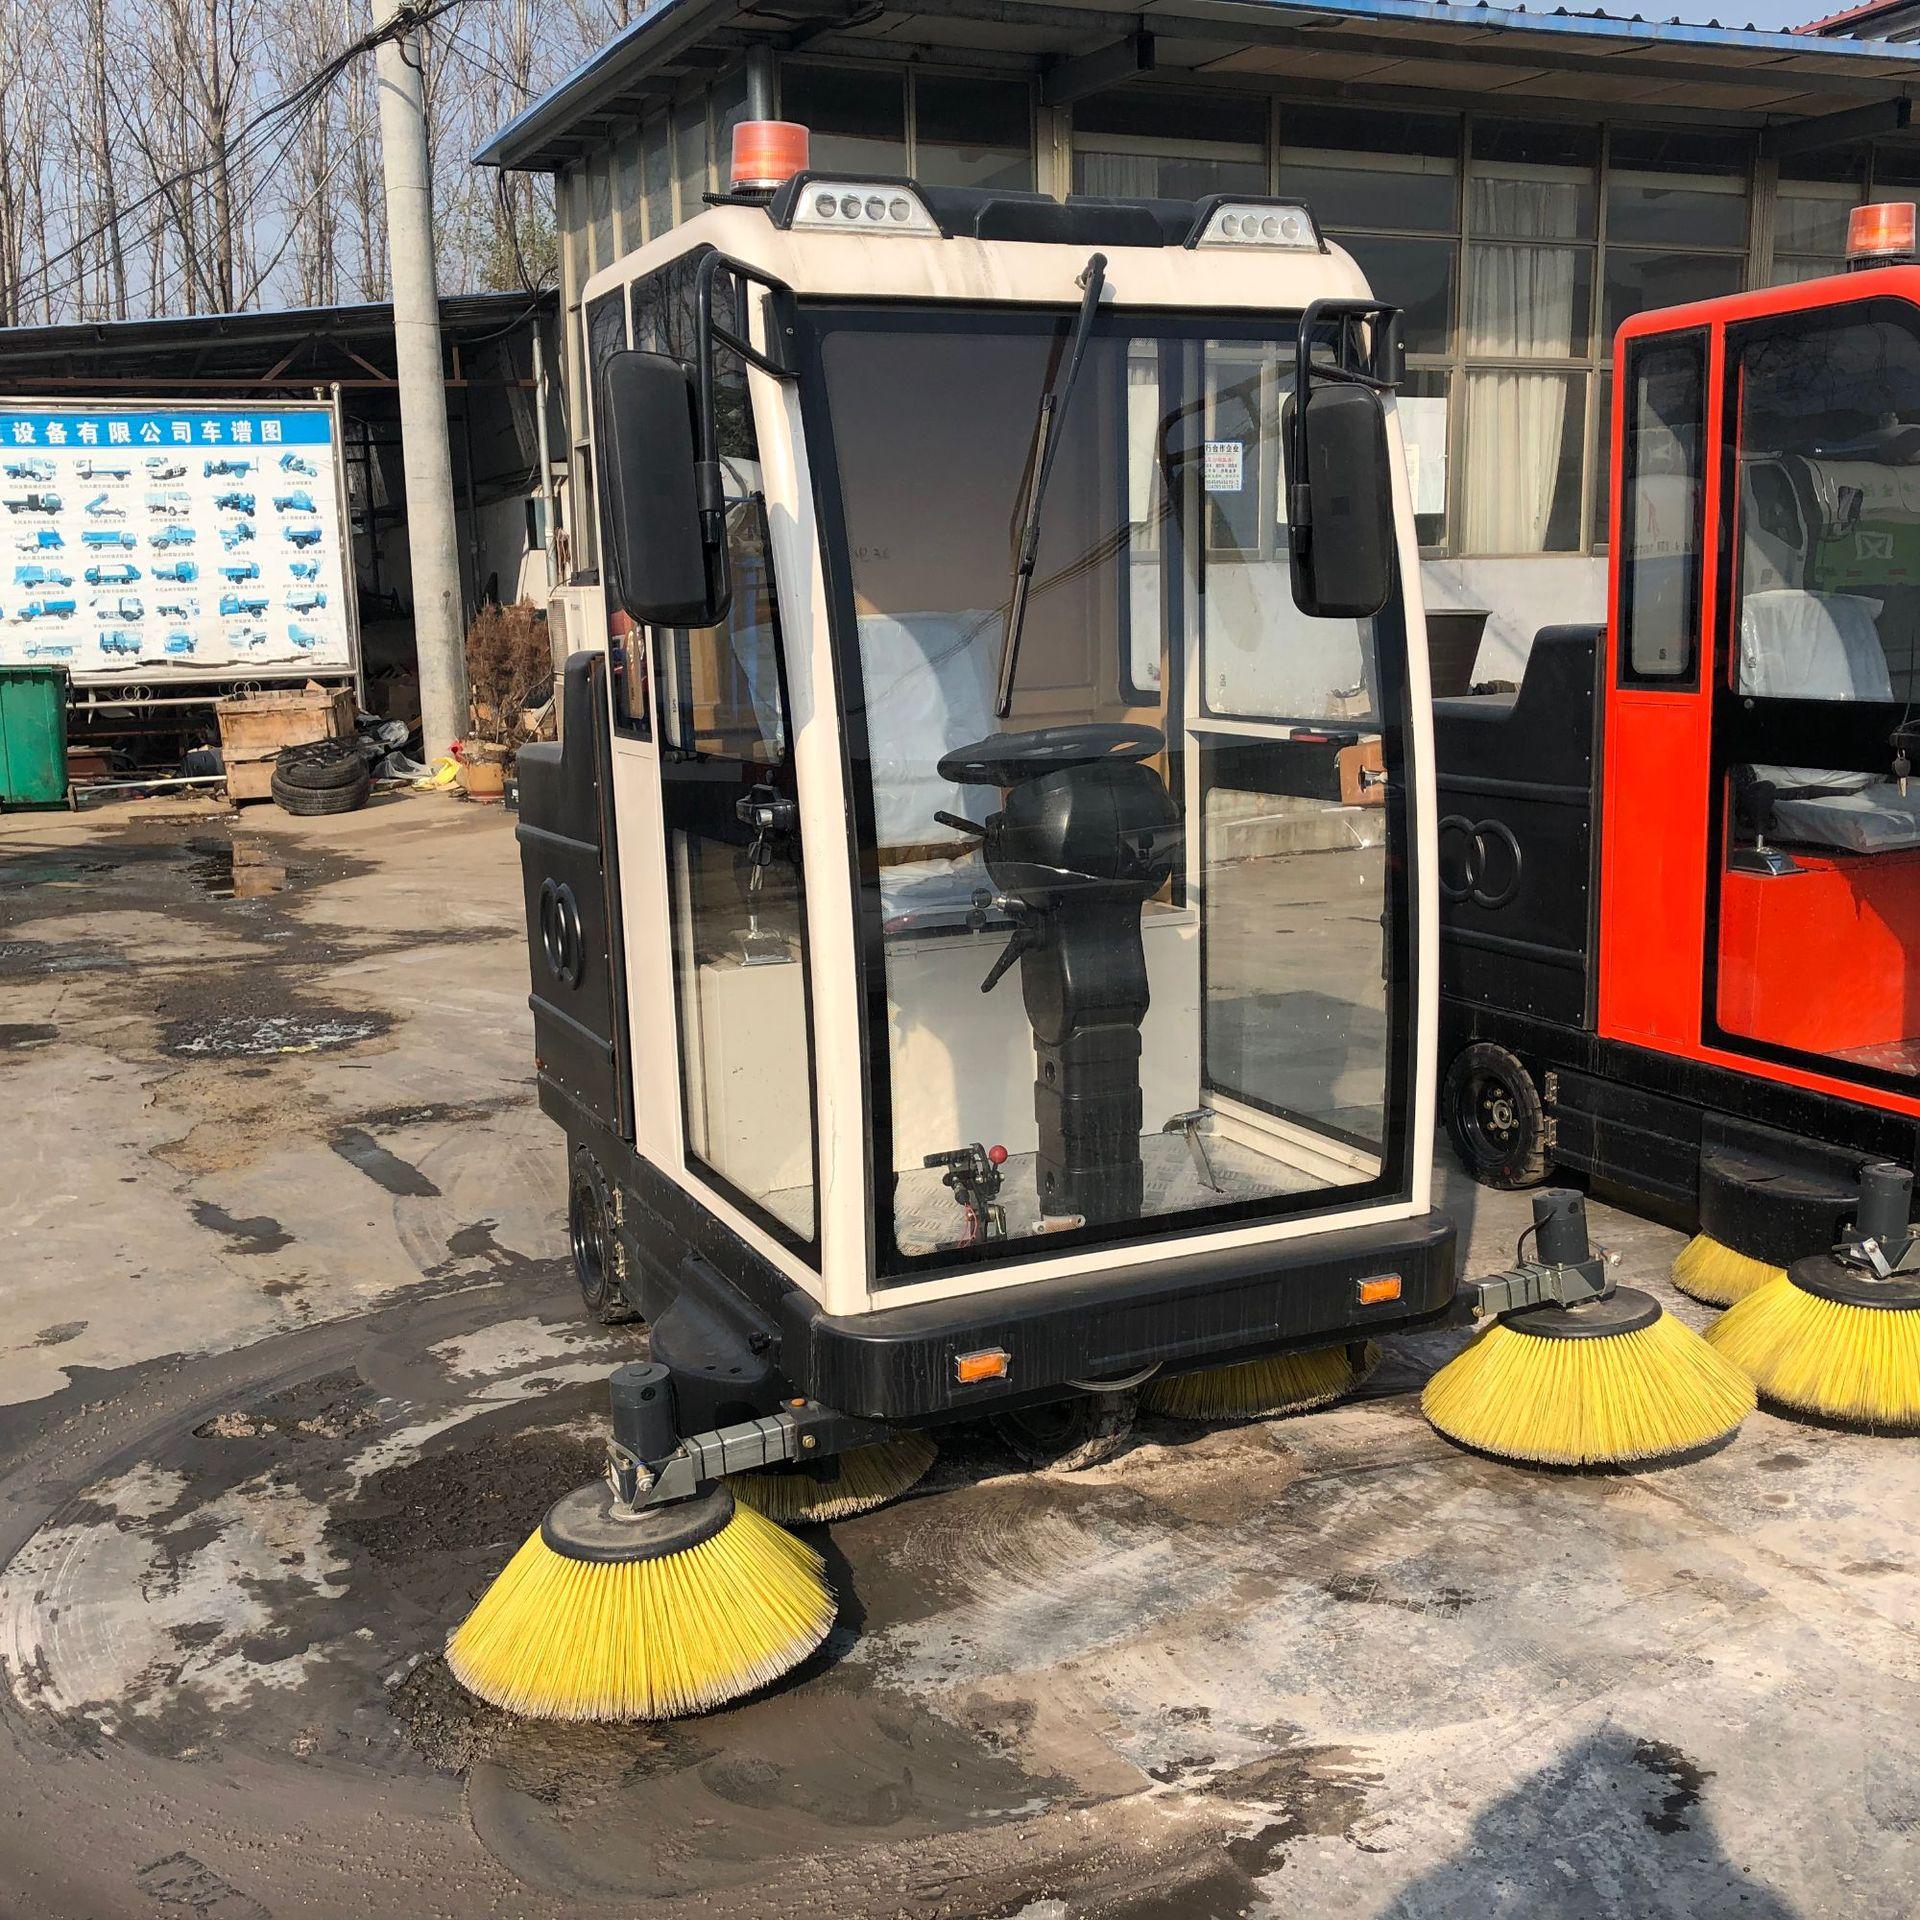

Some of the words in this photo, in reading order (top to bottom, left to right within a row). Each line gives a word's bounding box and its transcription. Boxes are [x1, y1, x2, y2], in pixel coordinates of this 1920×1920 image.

[0, 420, 282, 444] 设备有限公司车谱图
